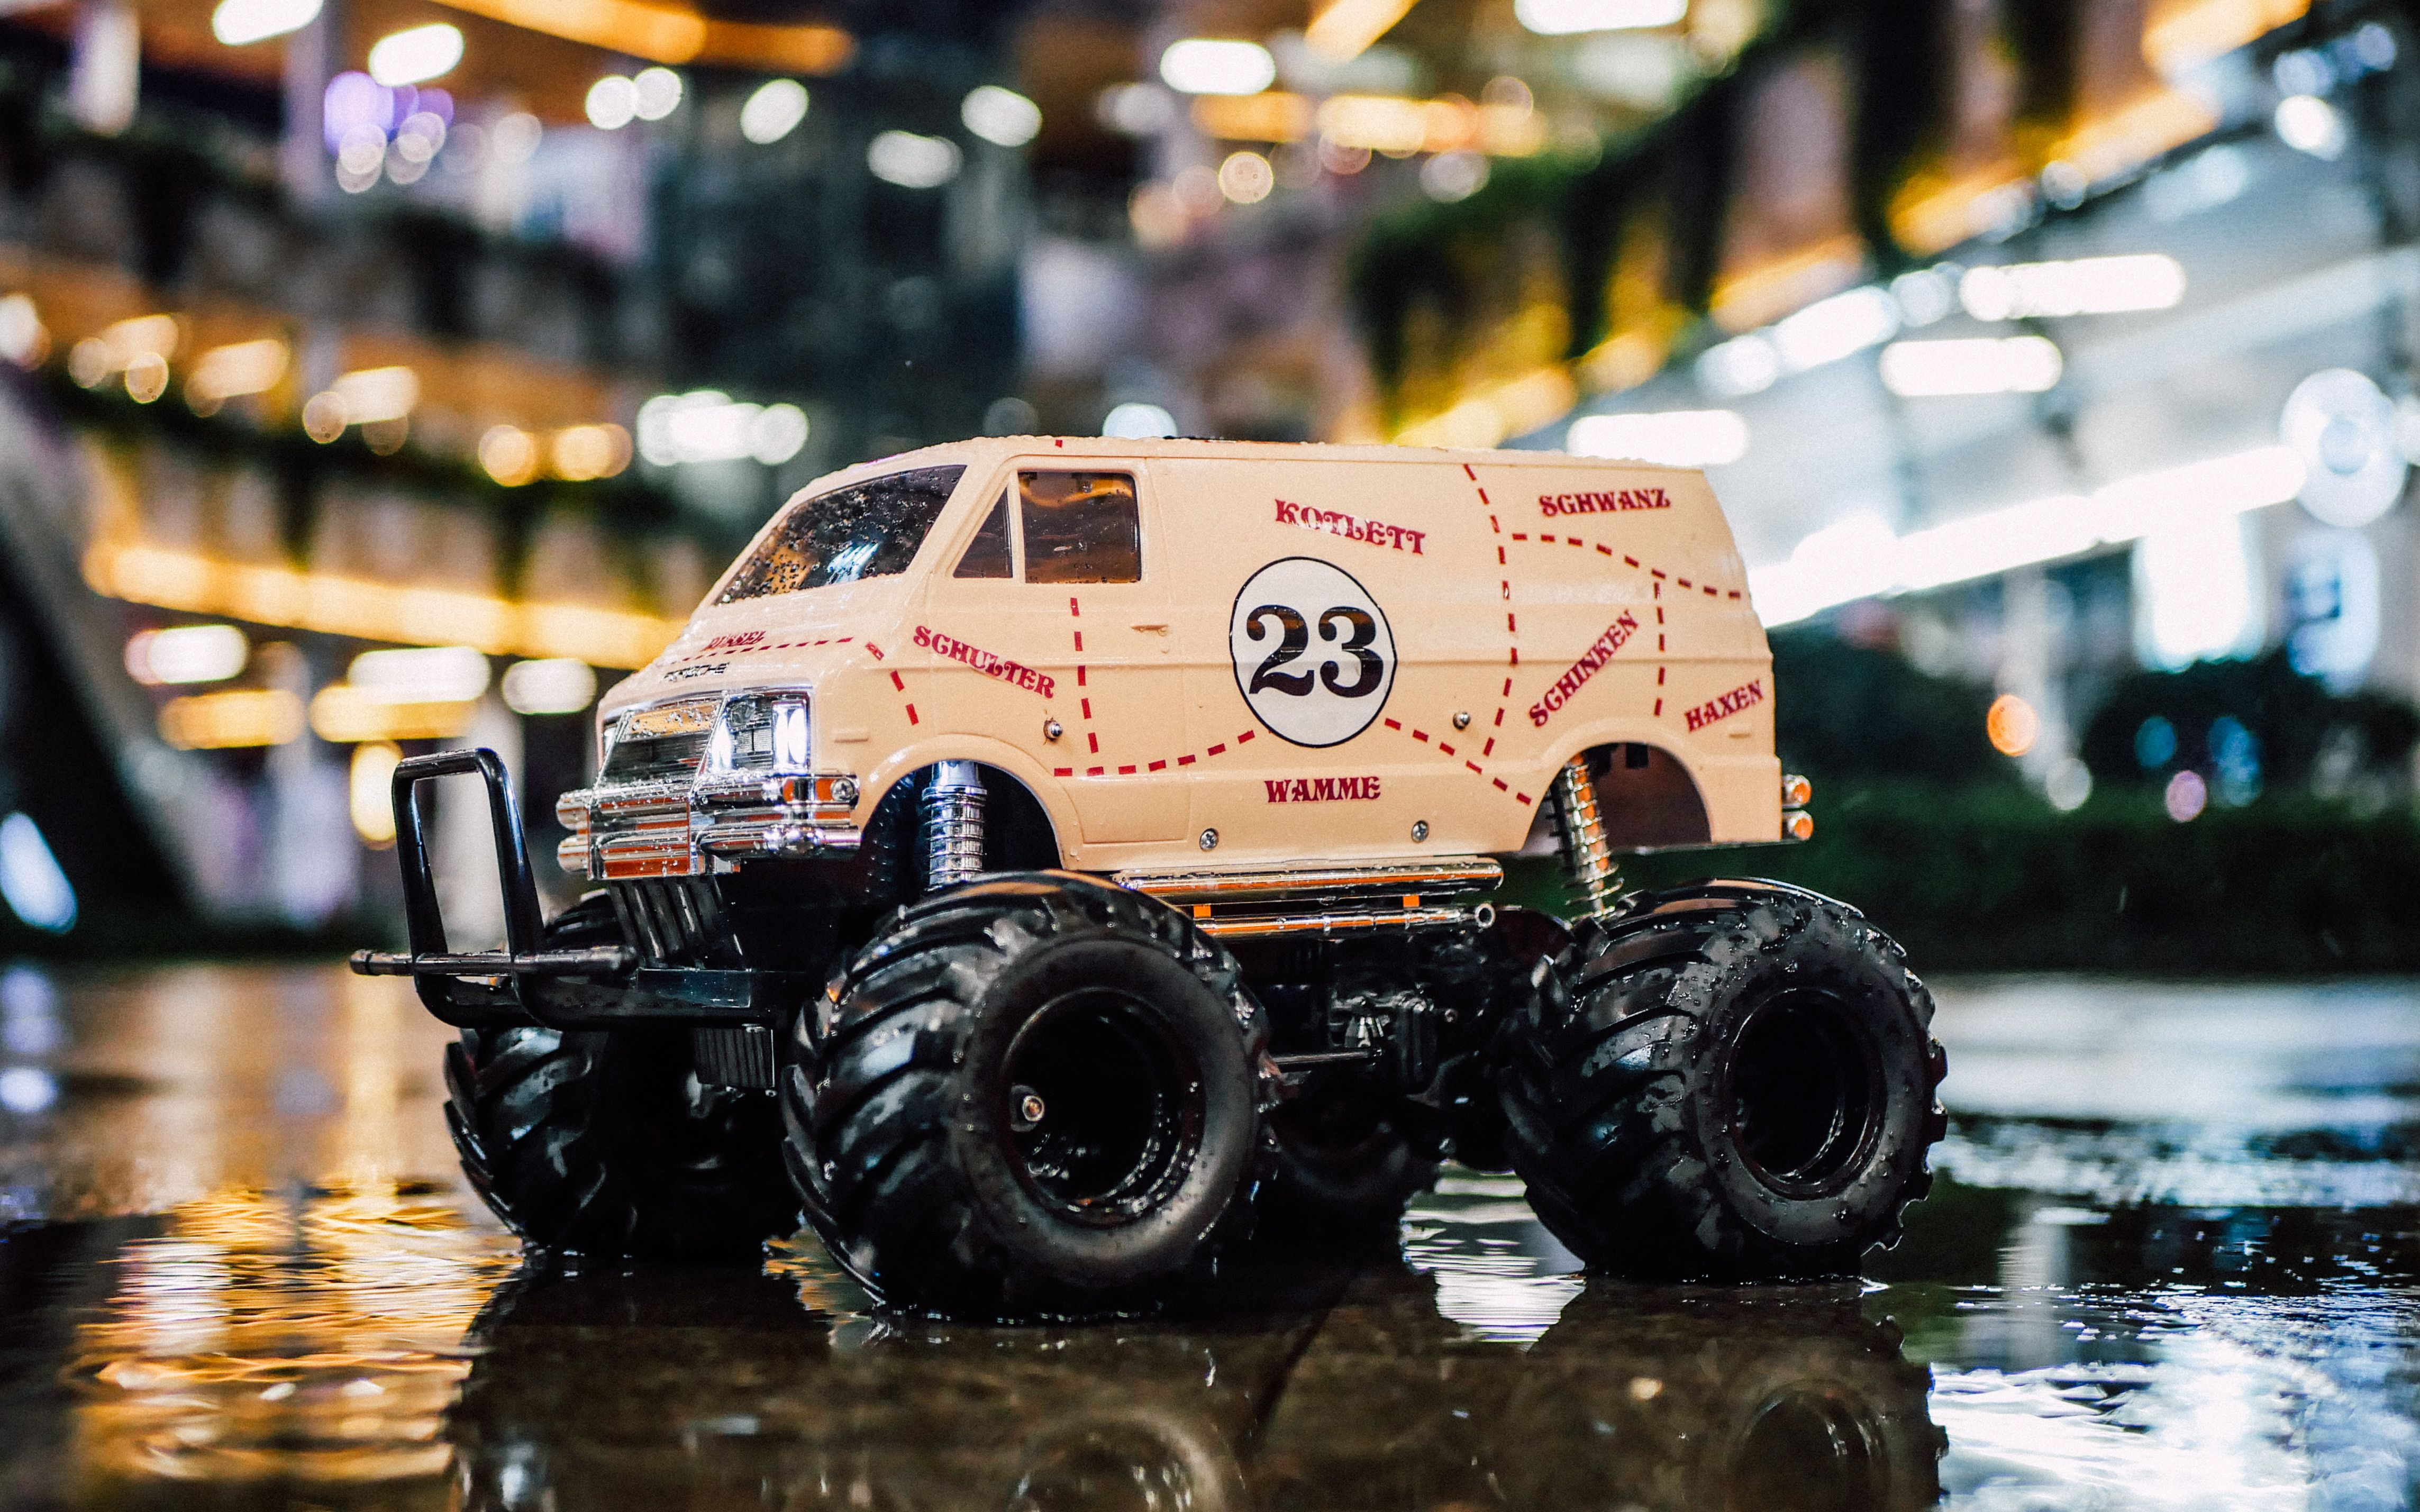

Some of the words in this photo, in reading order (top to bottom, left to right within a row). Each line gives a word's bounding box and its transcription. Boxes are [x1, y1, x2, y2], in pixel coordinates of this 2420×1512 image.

[1275, 499, 1425, 555] KOTLETT
[1539, 489, 1670, 517] SCHWANZ
[913, 626, 1054, 699] SCHULTER
[1247, 604, 1384, 698] 23
[1529, 610, 1639, 728] SCHINKEN
[1685, 679, 1763, 733] HAXEN
[1264, 776, 1380, 804] WAMME
